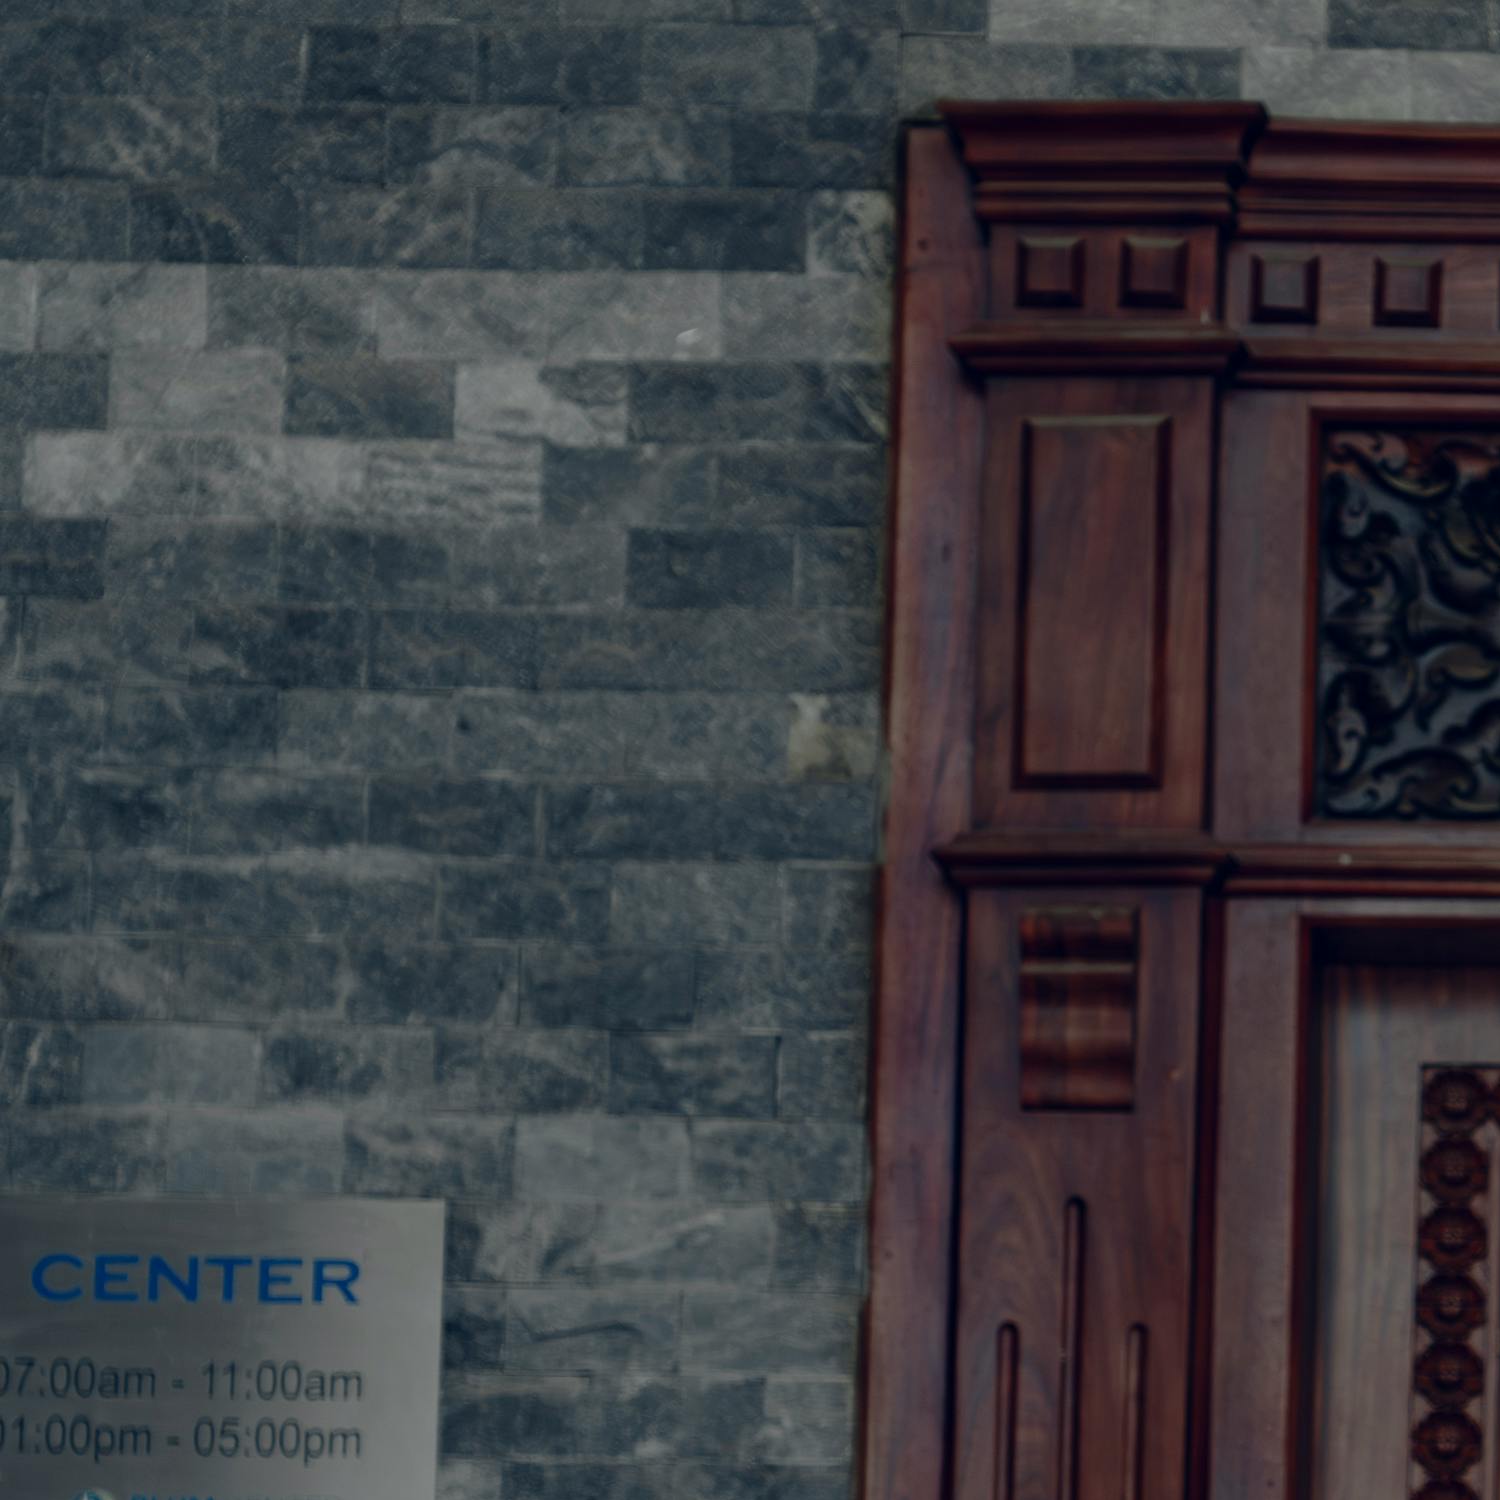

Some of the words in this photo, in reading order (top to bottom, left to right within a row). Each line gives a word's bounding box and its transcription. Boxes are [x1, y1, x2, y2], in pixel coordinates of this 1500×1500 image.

[31, 1253, 361, 1305] CENTER
[202, 1359, 363, 1402] 11:00am
[193, 1416, 362, 1467] 05:00pm
